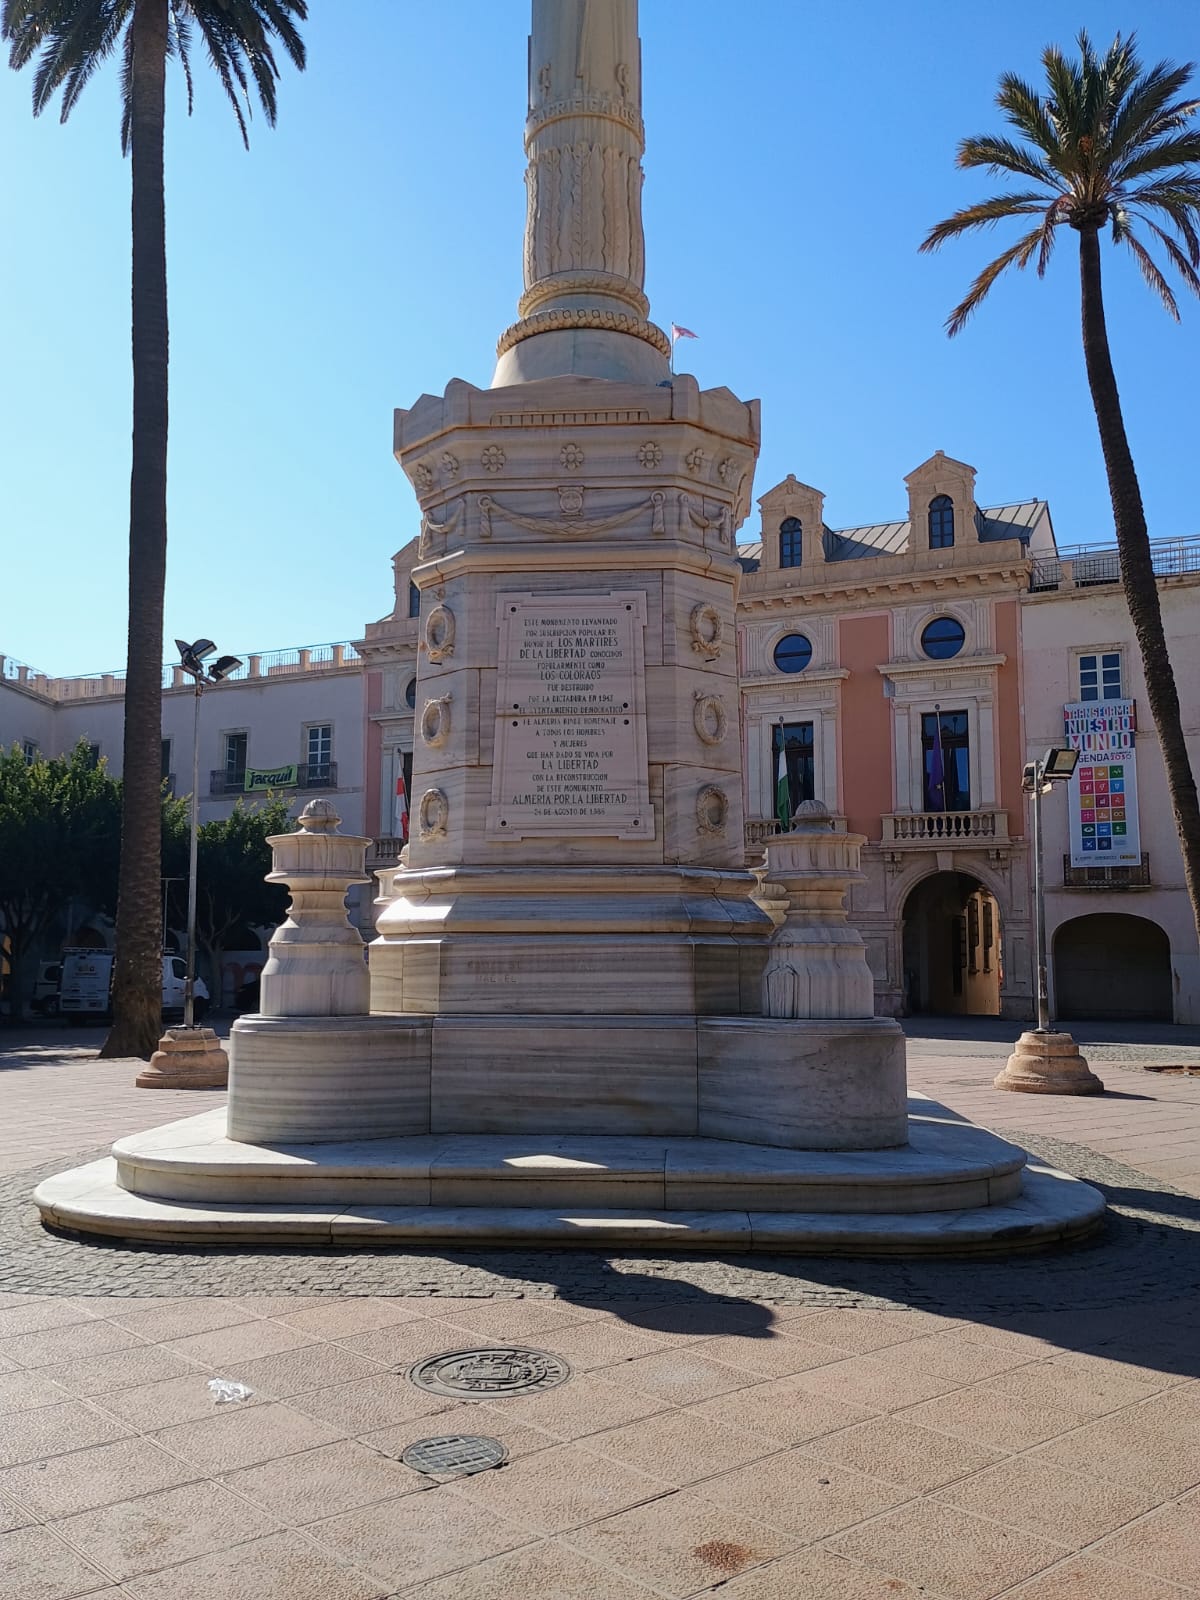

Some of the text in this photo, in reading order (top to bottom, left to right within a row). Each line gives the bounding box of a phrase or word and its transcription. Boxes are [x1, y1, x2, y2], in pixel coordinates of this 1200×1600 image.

[582, 618, 617, 626] LEVANTADO
[558, 638, 573, 647] LOS
[575, 637, 618, 647] MARTIRES
[520, 650, 531, 659] DE
[532, 650, 543, 659] LA
[546, 649, 587, 659] LIBERTAD
[540, 670, 601, 681] LOS COLORAOS
[552, 695, 587, 703] DICTADURA
[1065, 706, 1133, 719] TRANSFORMA
[583, 717, 616, 725] HOMENAJE
[1067, 717, 1131, 734] NUESTRO
[560, 740, 587, 748] MUJERES
[1067, 733, 1131, 751] MUNDO
[1078, 753, 1110, 763] GENDA
[542, 759, 599, 770] LA LIBERTAD
[248, 768, 293, 788] jarquil
[532, 774, 544, 782] CON
[556, 773, 608, 781] RECONSTRUCCION
[536, 785, 544, 793] DE
[512, 793, 628, 805] ALMERIA POR LA LIBERTAD
[554, 808, 577, 816] AGOSTO
[579, 808, 587, 816] DE
